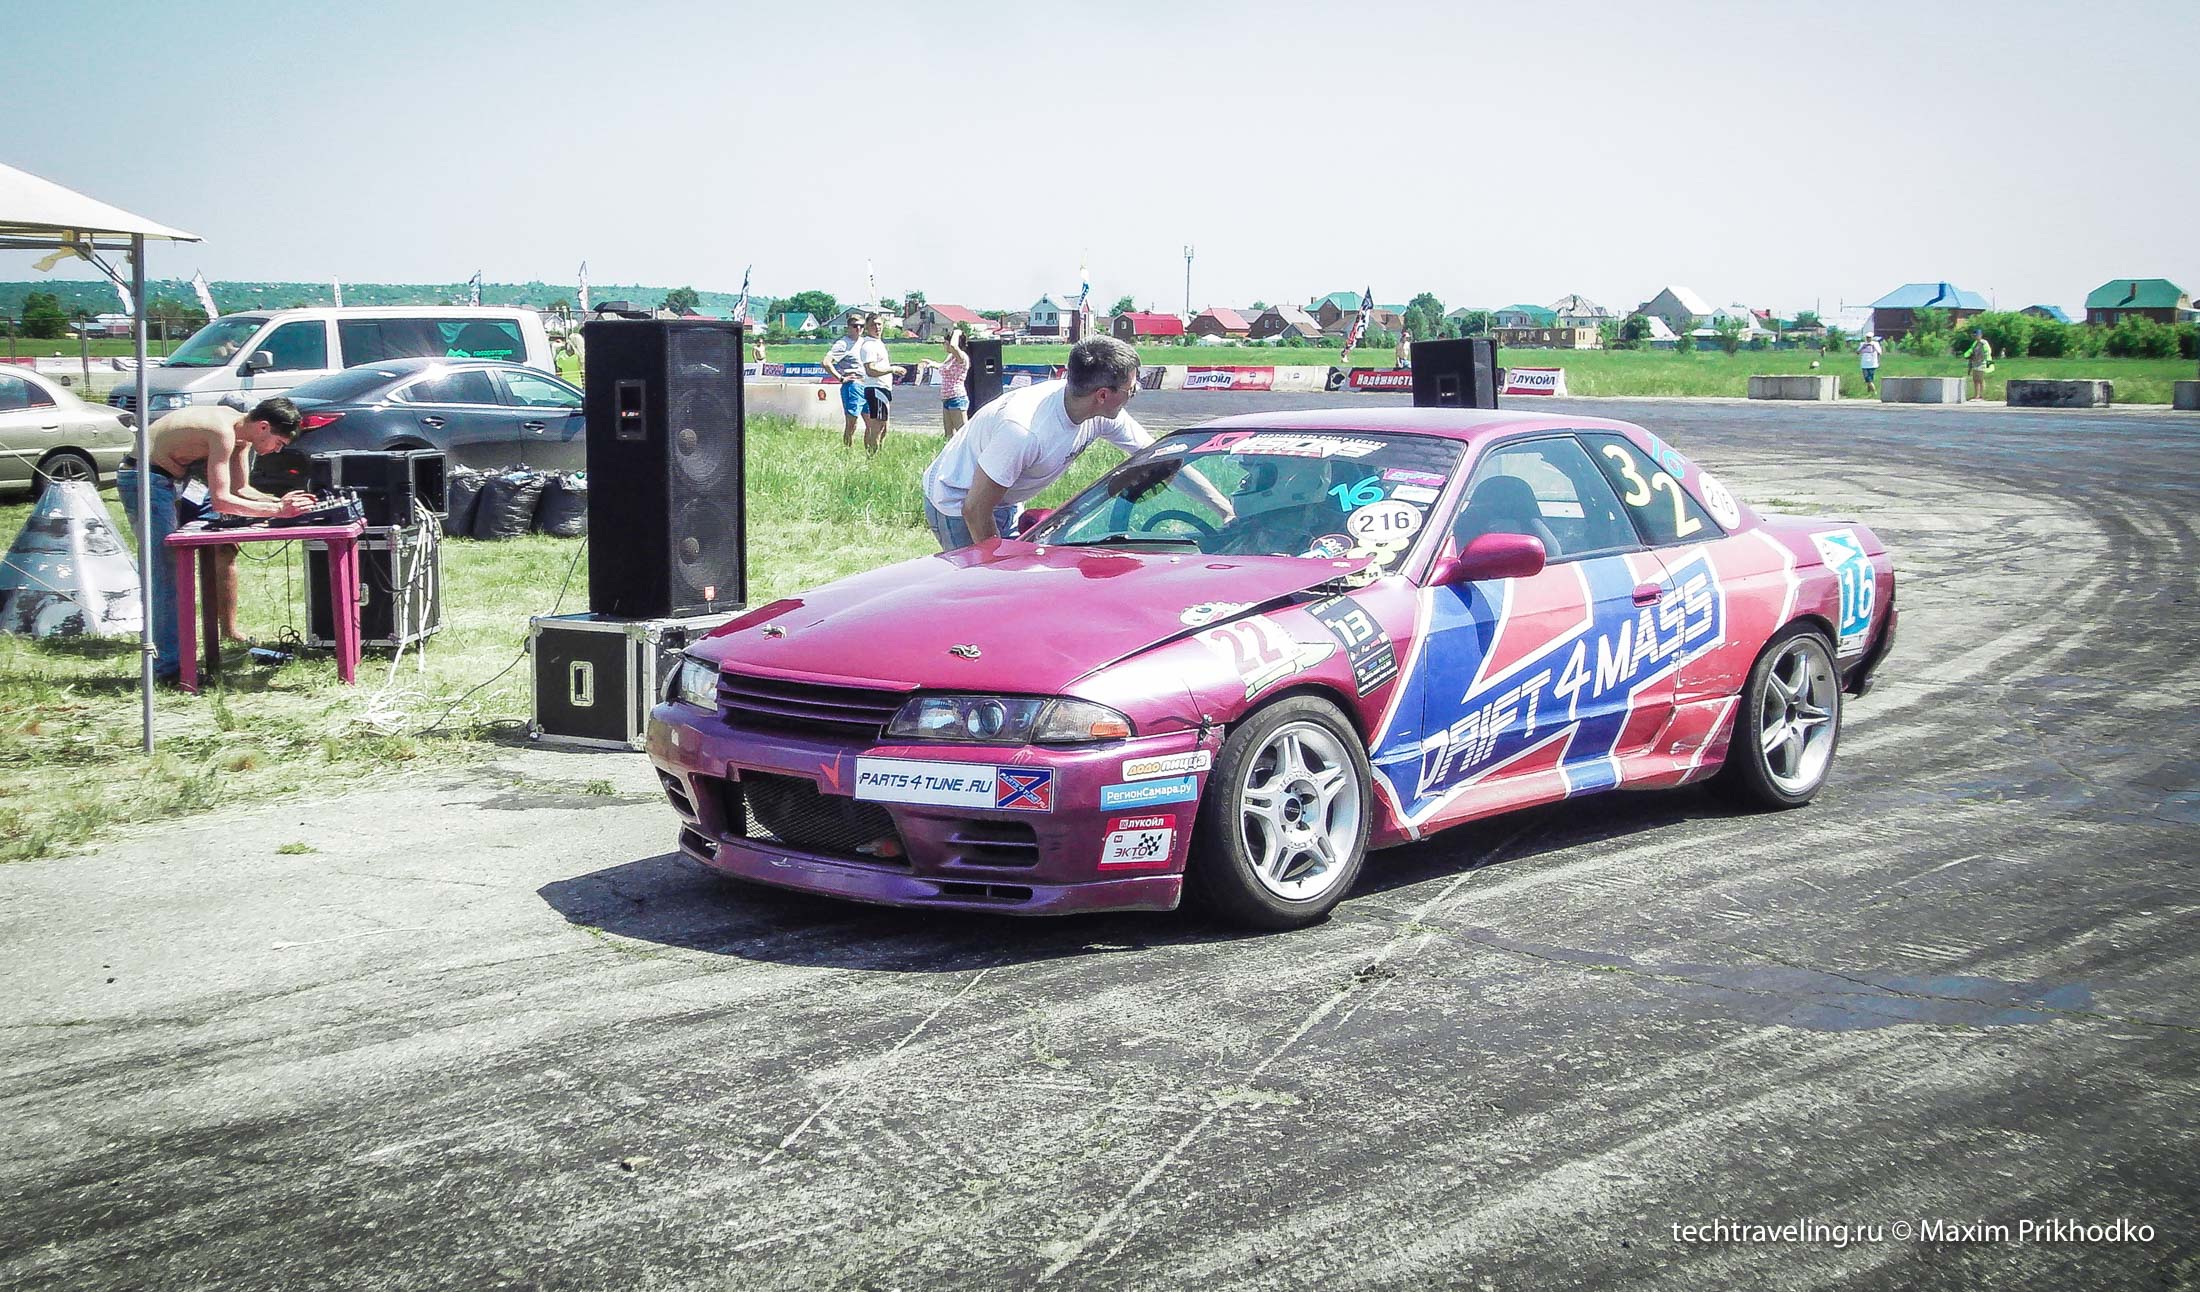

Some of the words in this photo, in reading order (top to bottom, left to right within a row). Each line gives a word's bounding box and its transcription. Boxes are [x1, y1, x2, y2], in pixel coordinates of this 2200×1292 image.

[1516, 374, 1556, 386] ЛУКОЙЛ
[1328, 475, 1384, 512] 16
[1359, 511, 1410, 533] 216
[1842, 560, 1874, 629] 16
[1334, 608, 1375, 648] 13
[1210, 620, 1283, 676] 22
[1420, 669, 1551, 790] DRIFT
[1554, 640, 1592, 722] 4
[1592, 572, 1714, 698] MASS
[1107, 783, 1192, 801] РегионСамара.ру
[1127, 817, 1164, 829] ЛУКОЙЛ
[1113, 846, 1148, 858] ЭКТО
